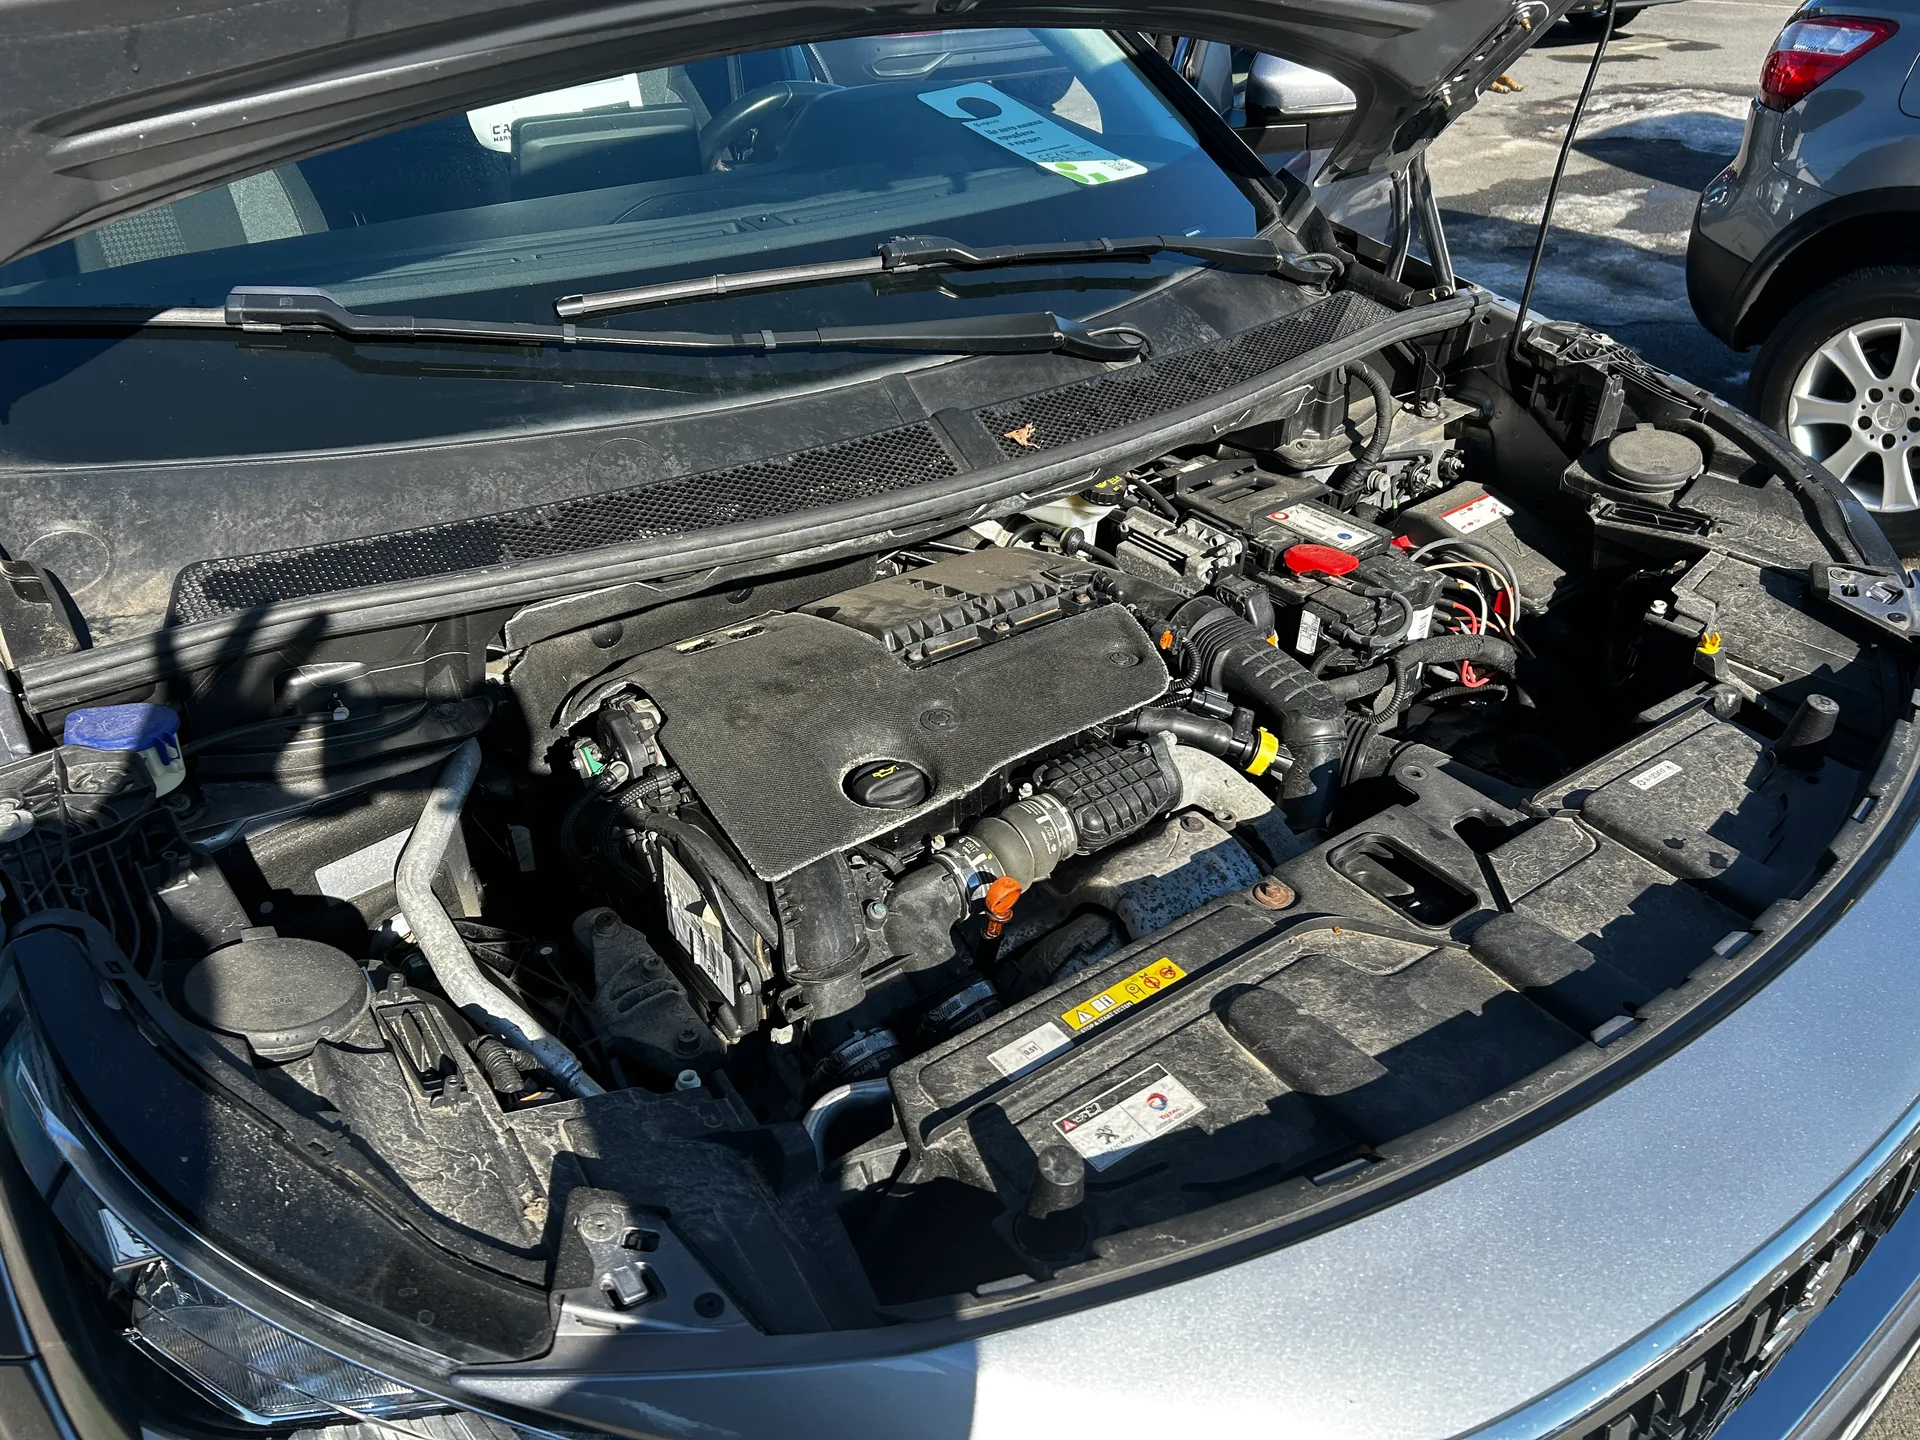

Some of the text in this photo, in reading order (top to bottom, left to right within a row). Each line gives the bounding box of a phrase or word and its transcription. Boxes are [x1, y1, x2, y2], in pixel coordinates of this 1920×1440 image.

[1080, 1023, 1094, 1033] STOP
[1099, 1012, 1114, 1025] START
[1114, 1001, 1133, 1016] SYSTEM
[1023, 1045, 1039, 1057] 0.51
[1159, 1107, 1182, 1121] TOTAL
